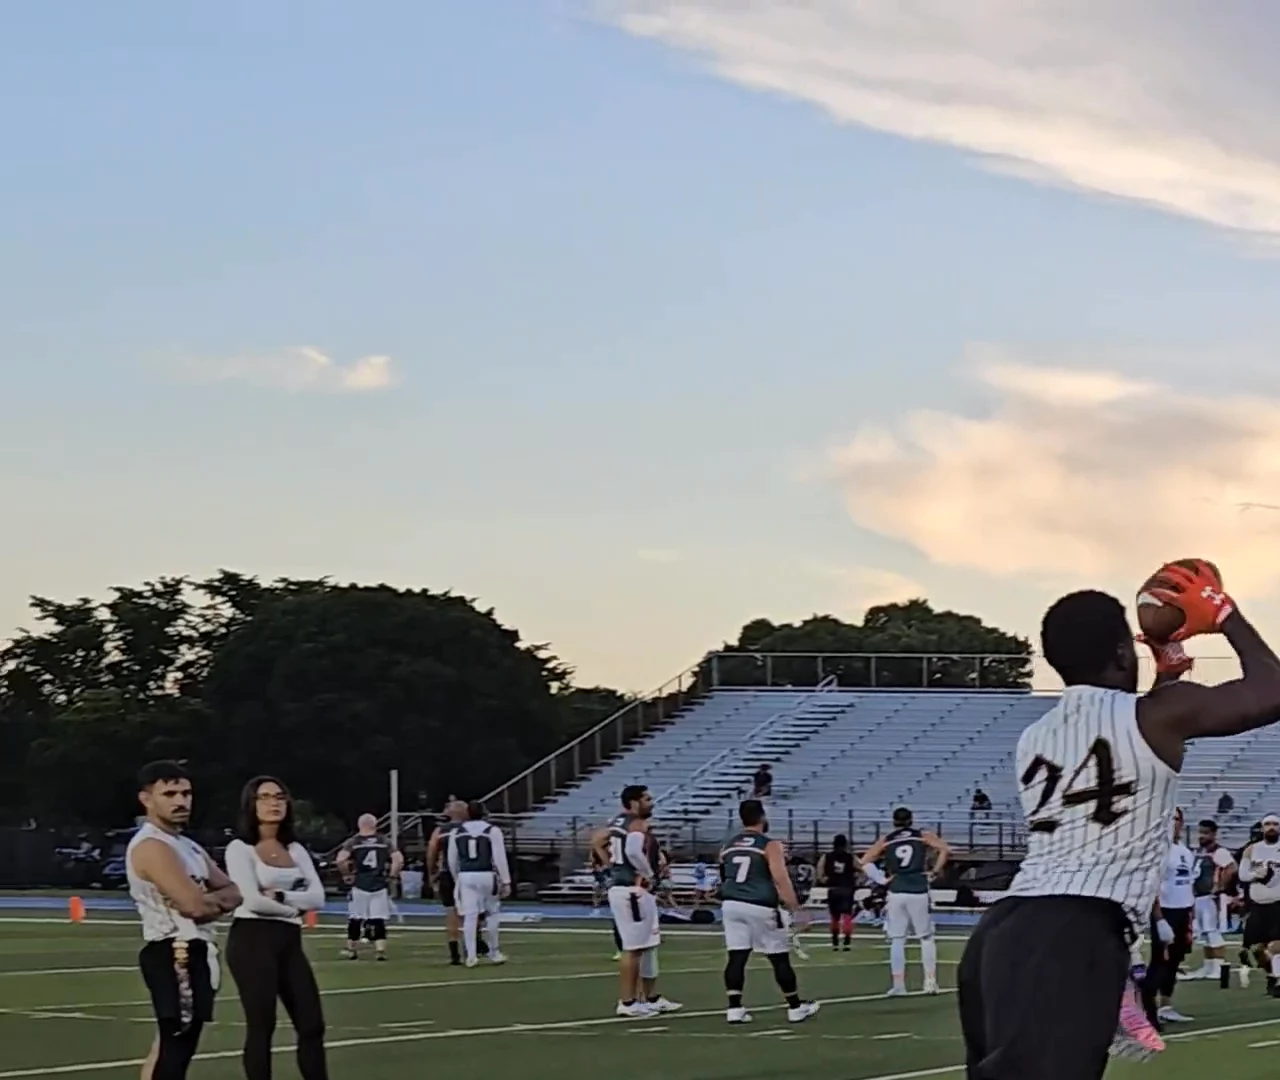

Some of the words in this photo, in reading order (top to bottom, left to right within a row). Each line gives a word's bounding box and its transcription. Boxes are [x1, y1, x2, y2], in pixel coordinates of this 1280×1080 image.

[1020, 735, 1138, 834] 24
[363, 850, 377, 869] 4
[468, 839, 477, 859] 1
[895, 844, 914, 867] 9
[732, 856, 750, 883] 7
